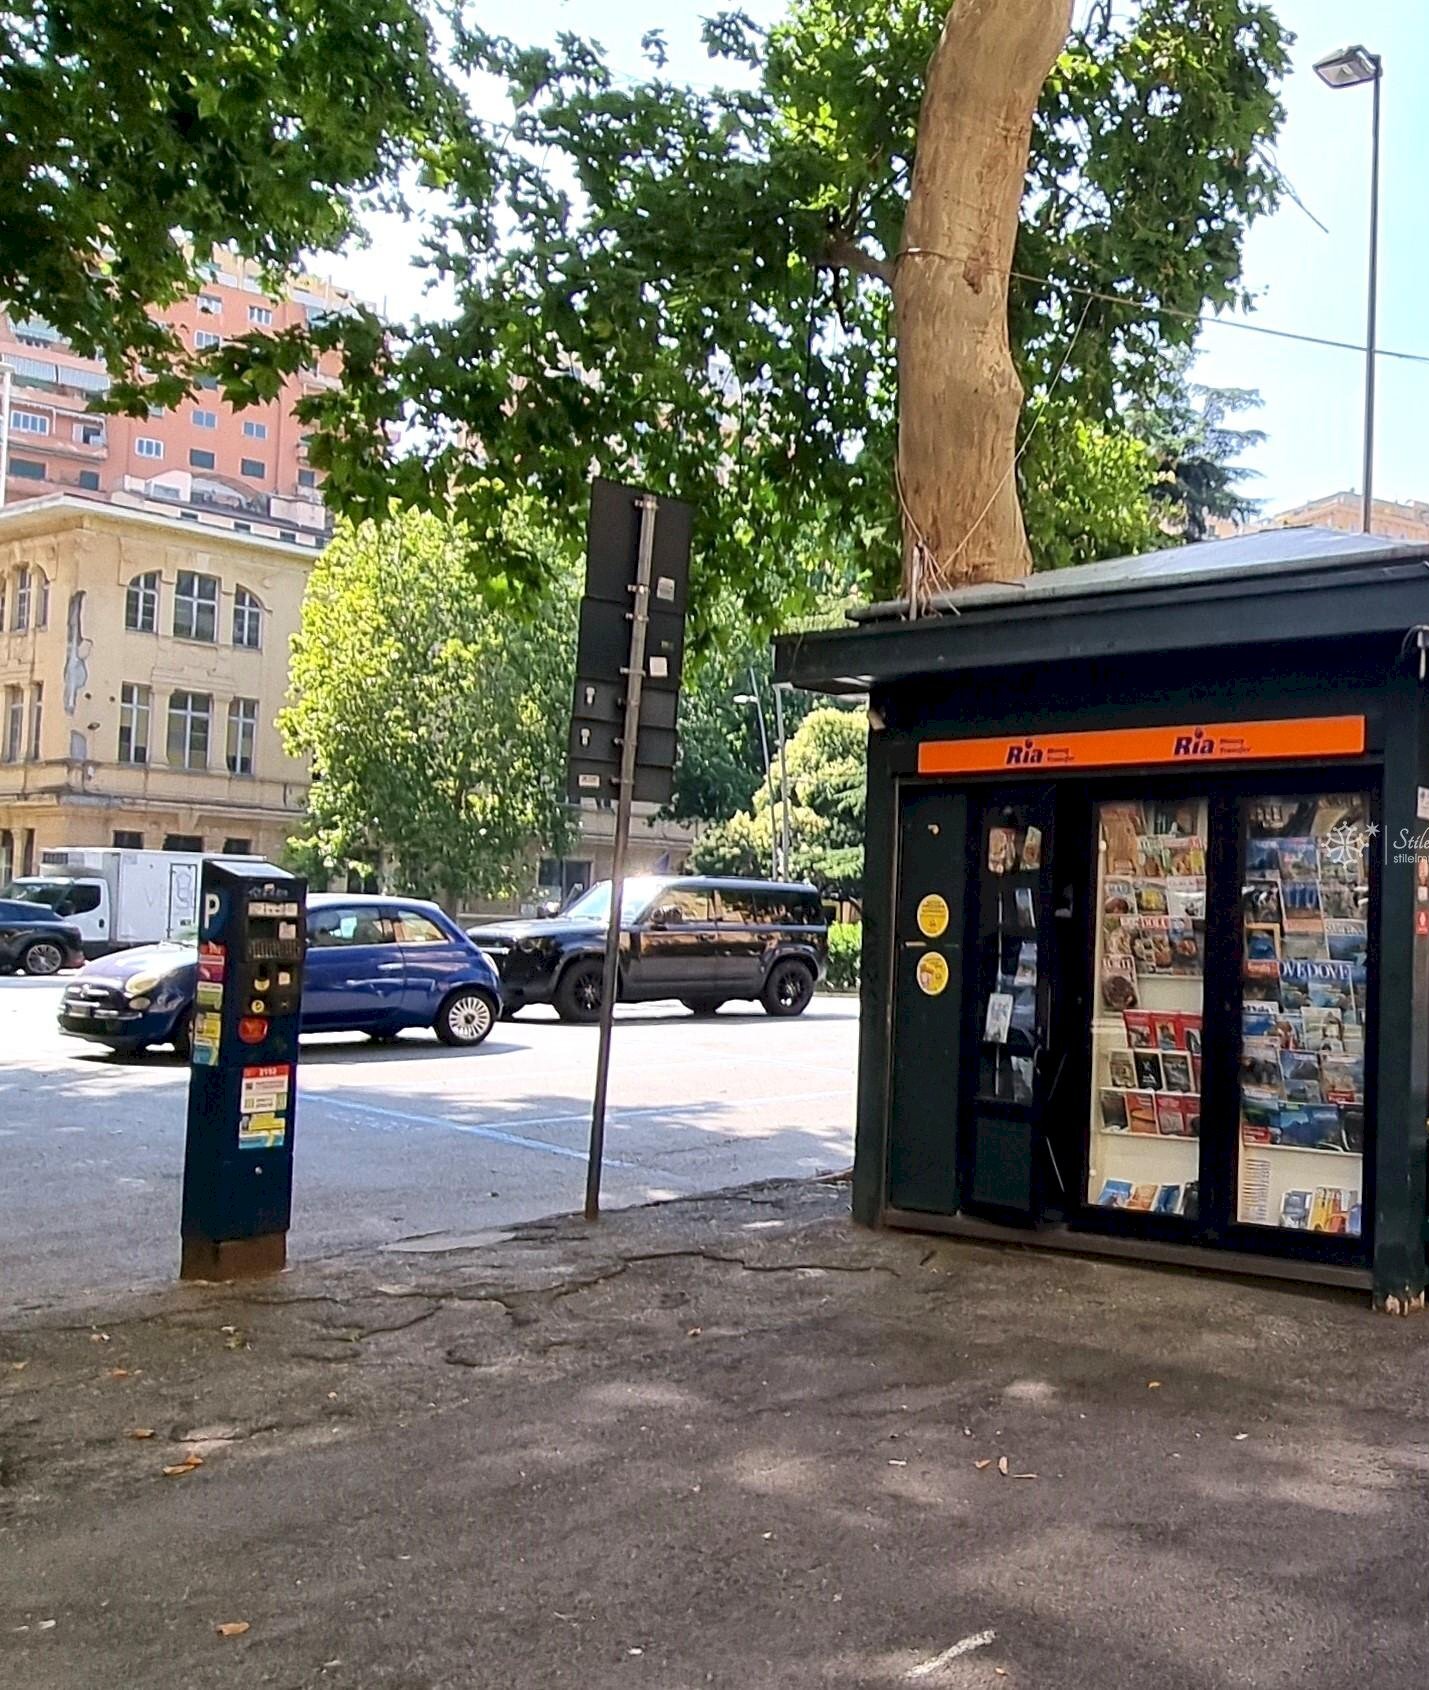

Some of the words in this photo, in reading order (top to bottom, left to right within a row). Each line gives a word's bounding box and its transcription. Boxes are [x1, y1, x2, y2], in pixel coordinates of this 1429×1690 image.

[1006, 739, 1043, 765] Ria
[1174, 727, 1214, 755] Ria
[204, 893, 221, 929] P
